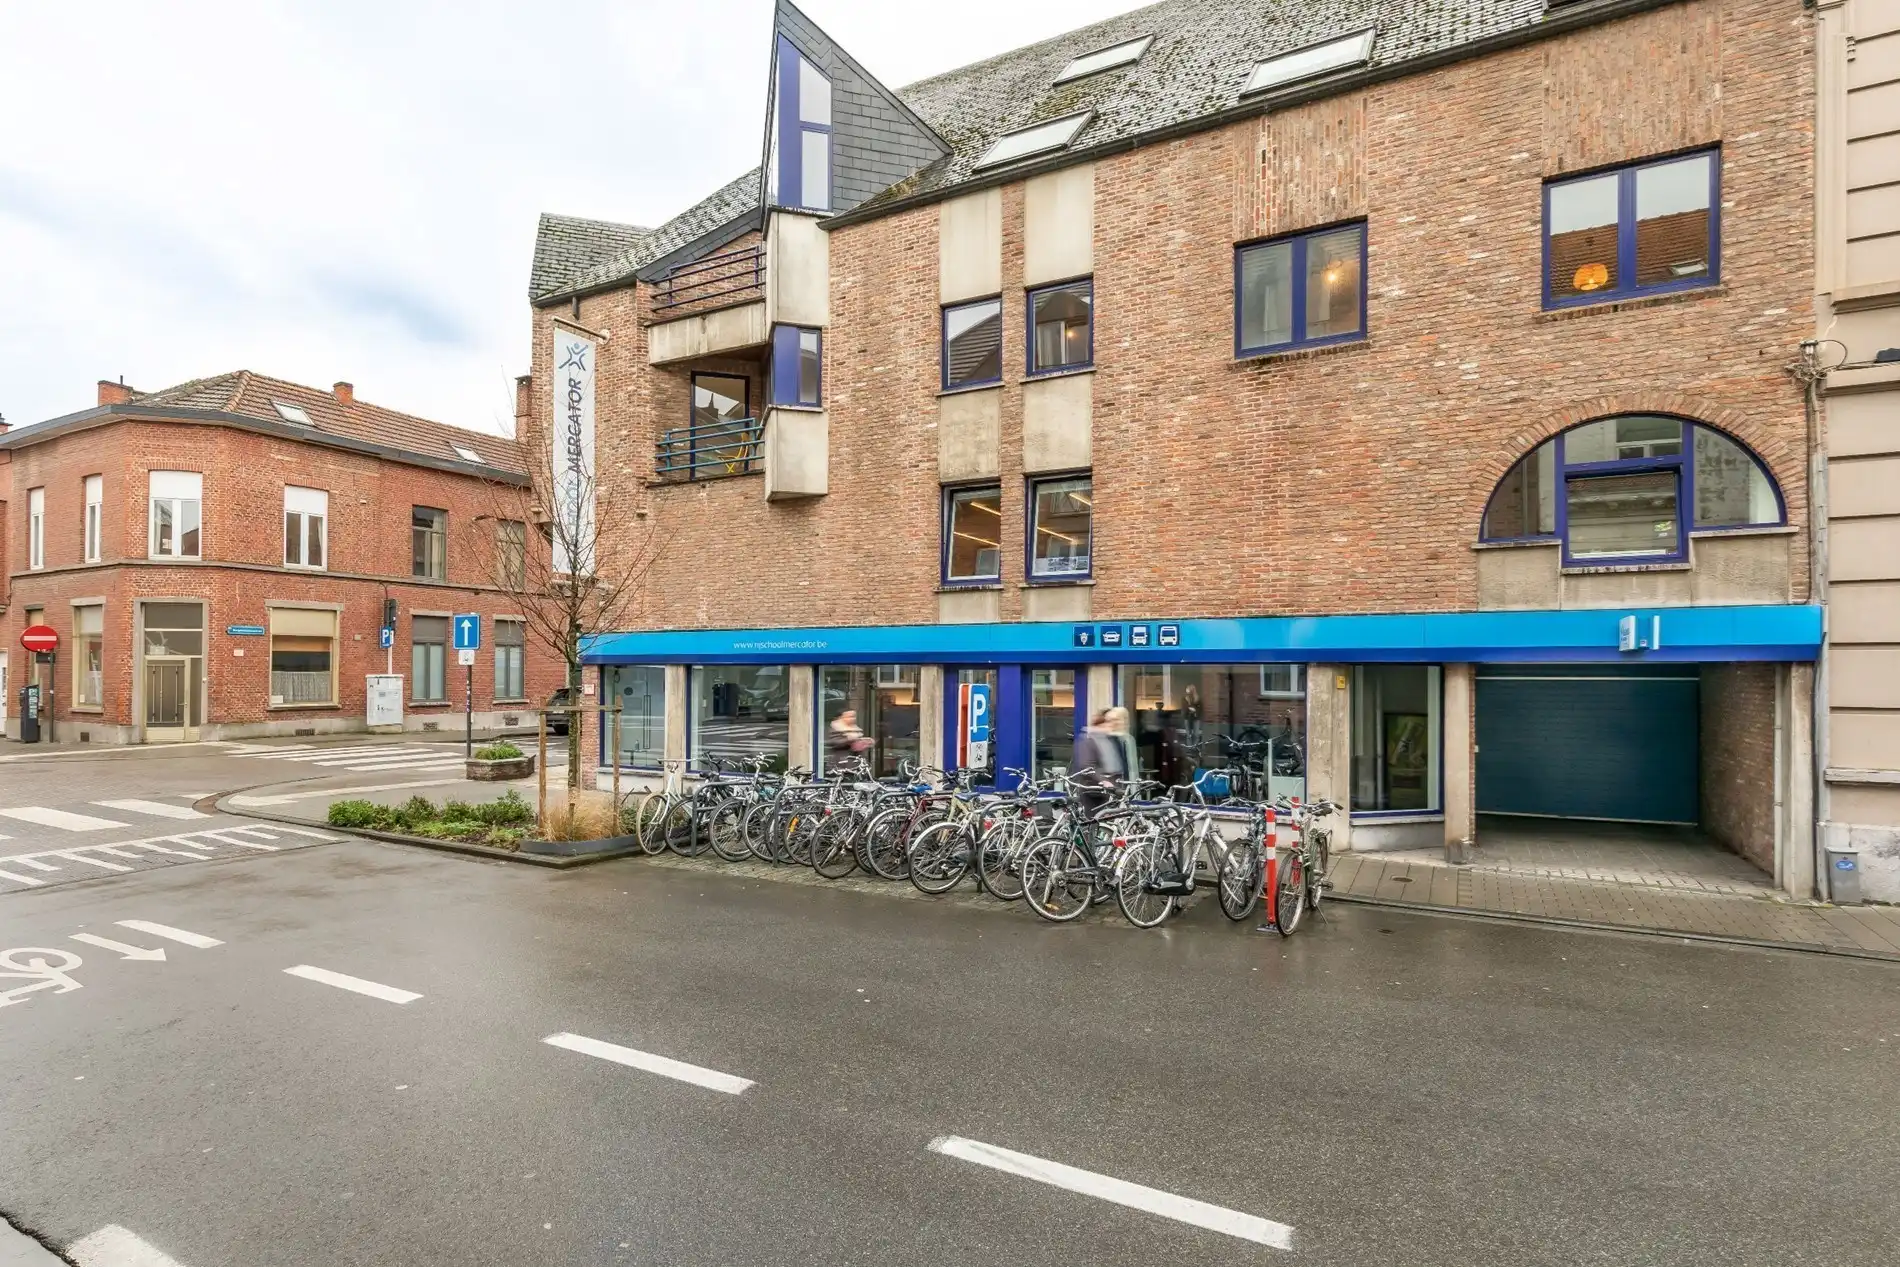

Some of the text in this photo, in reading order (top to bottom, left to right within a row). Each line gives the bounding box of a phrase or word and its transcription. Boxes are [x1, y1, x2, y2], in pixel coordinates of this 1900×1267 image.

[567, 378, 582, 474] MERCATOR
[382, 629, 390, 644] P
[973, 693, 987, 734] P
